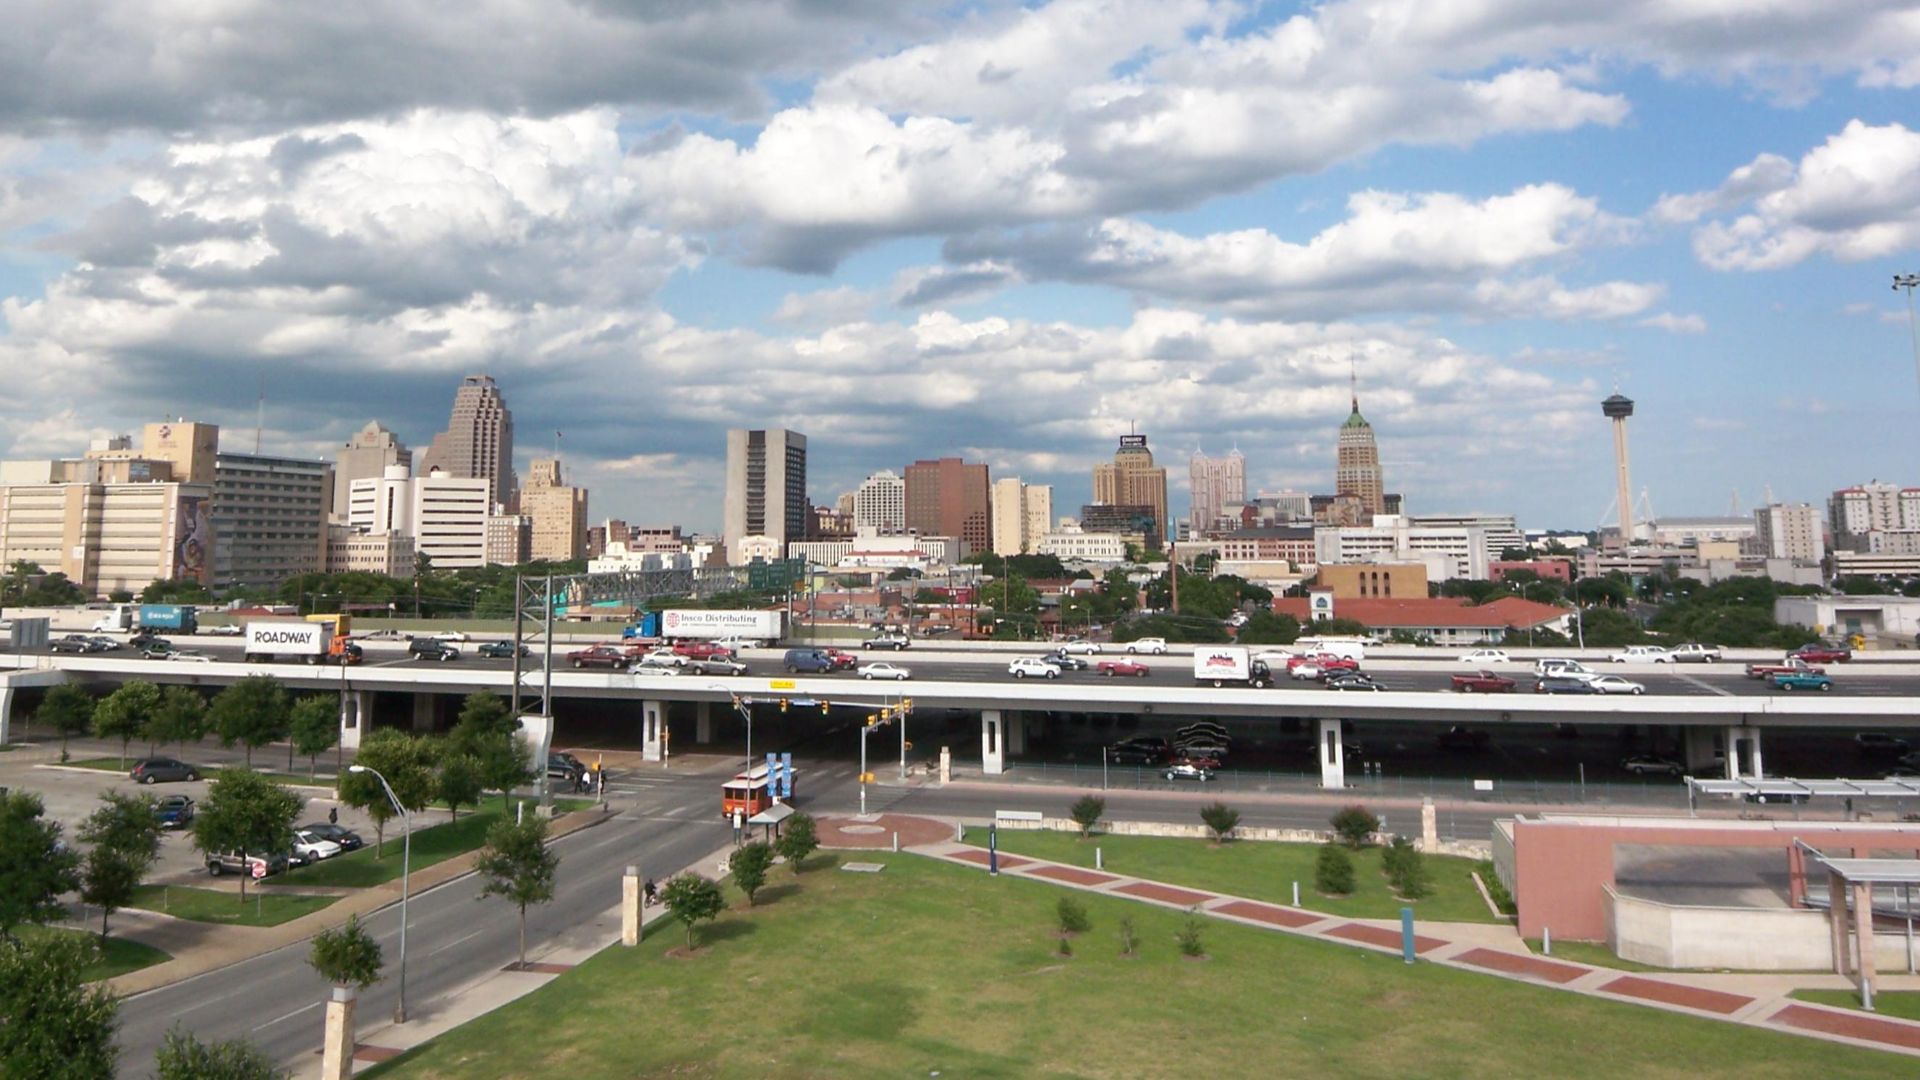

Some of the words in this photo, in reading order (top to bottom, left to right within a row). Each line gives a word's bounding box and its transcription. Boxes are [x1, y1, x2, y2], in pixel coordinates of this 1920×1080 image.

[681, 613, 702, 623] Insco
[706, 613, 757, 623] Distributing
[255, 631, 312, 644] ROADWAY
